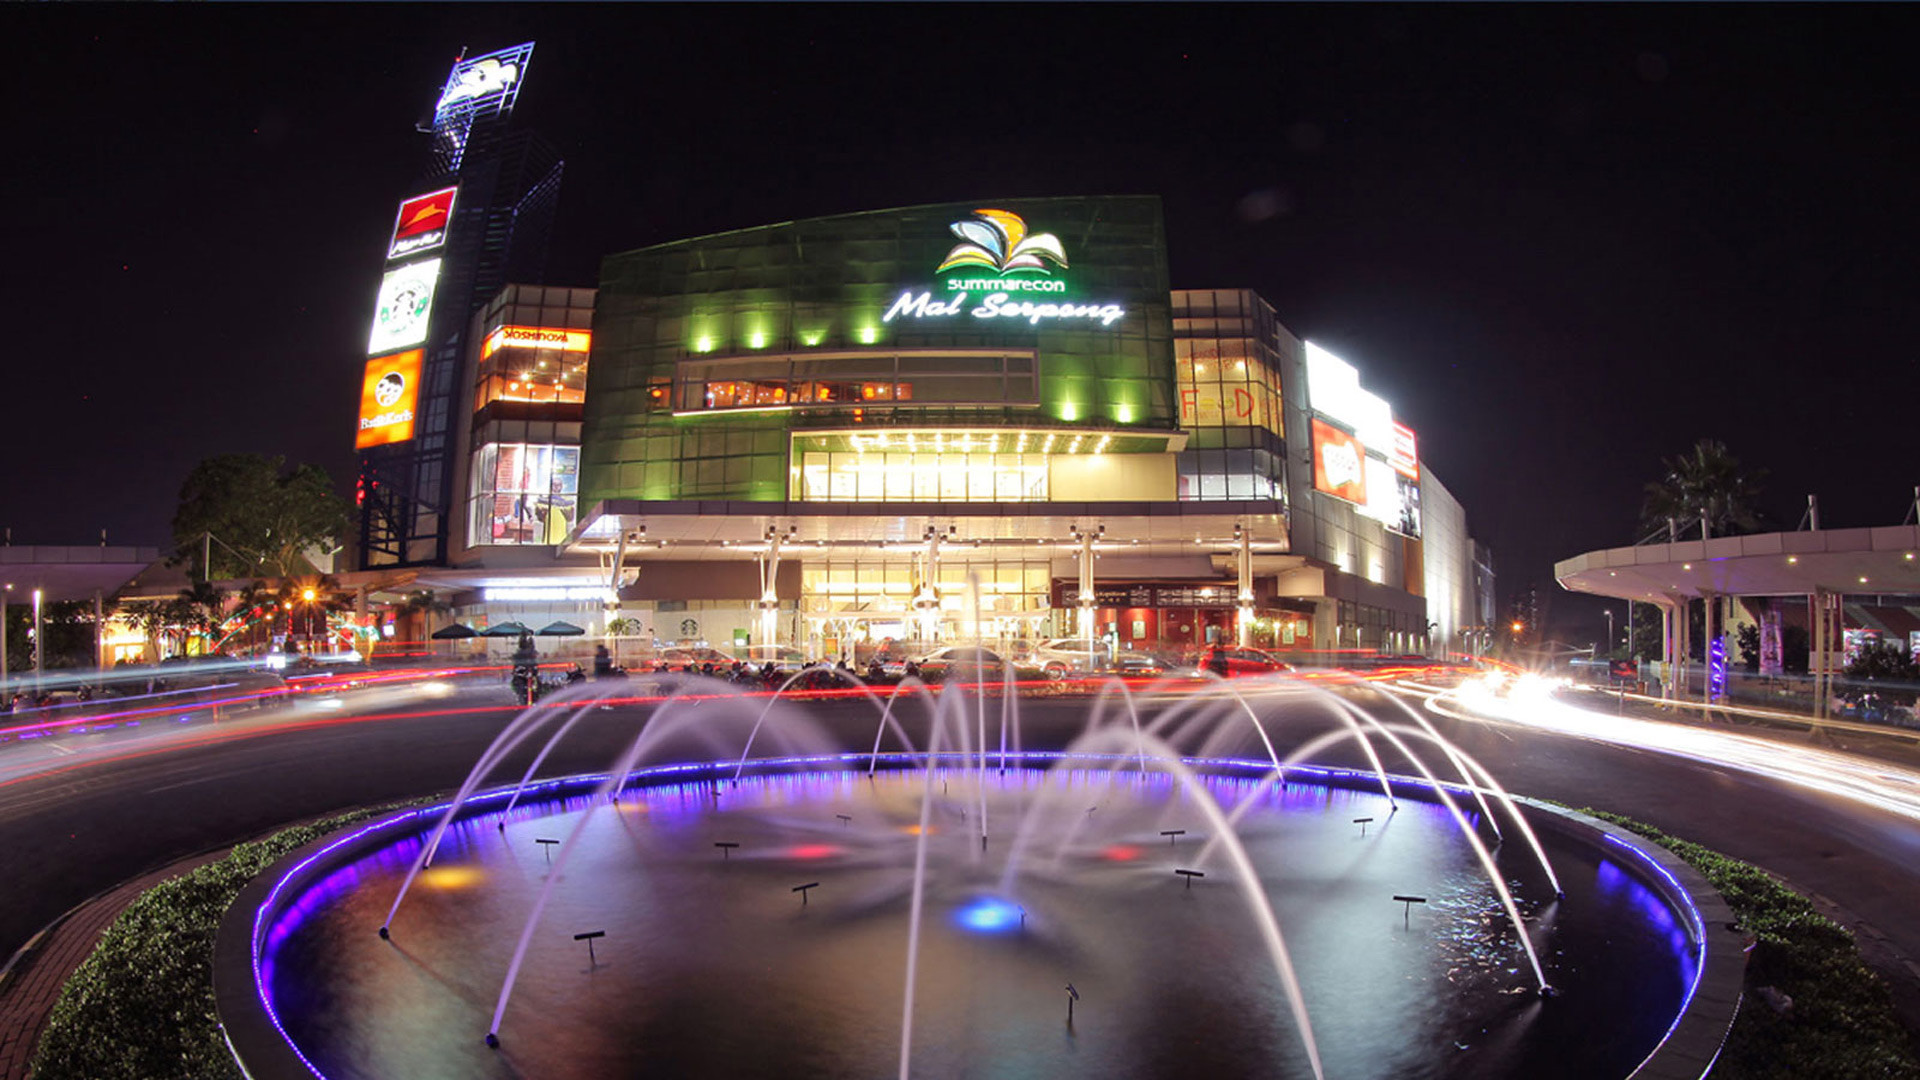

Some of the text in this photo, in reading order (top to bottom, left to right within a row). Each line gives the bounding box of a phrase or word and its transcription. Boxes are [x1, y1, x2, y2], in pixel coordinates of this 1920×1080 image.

[947, 279, 1065, 292] summarecon
[883, 292, 1126, 326] Mal Serpong
